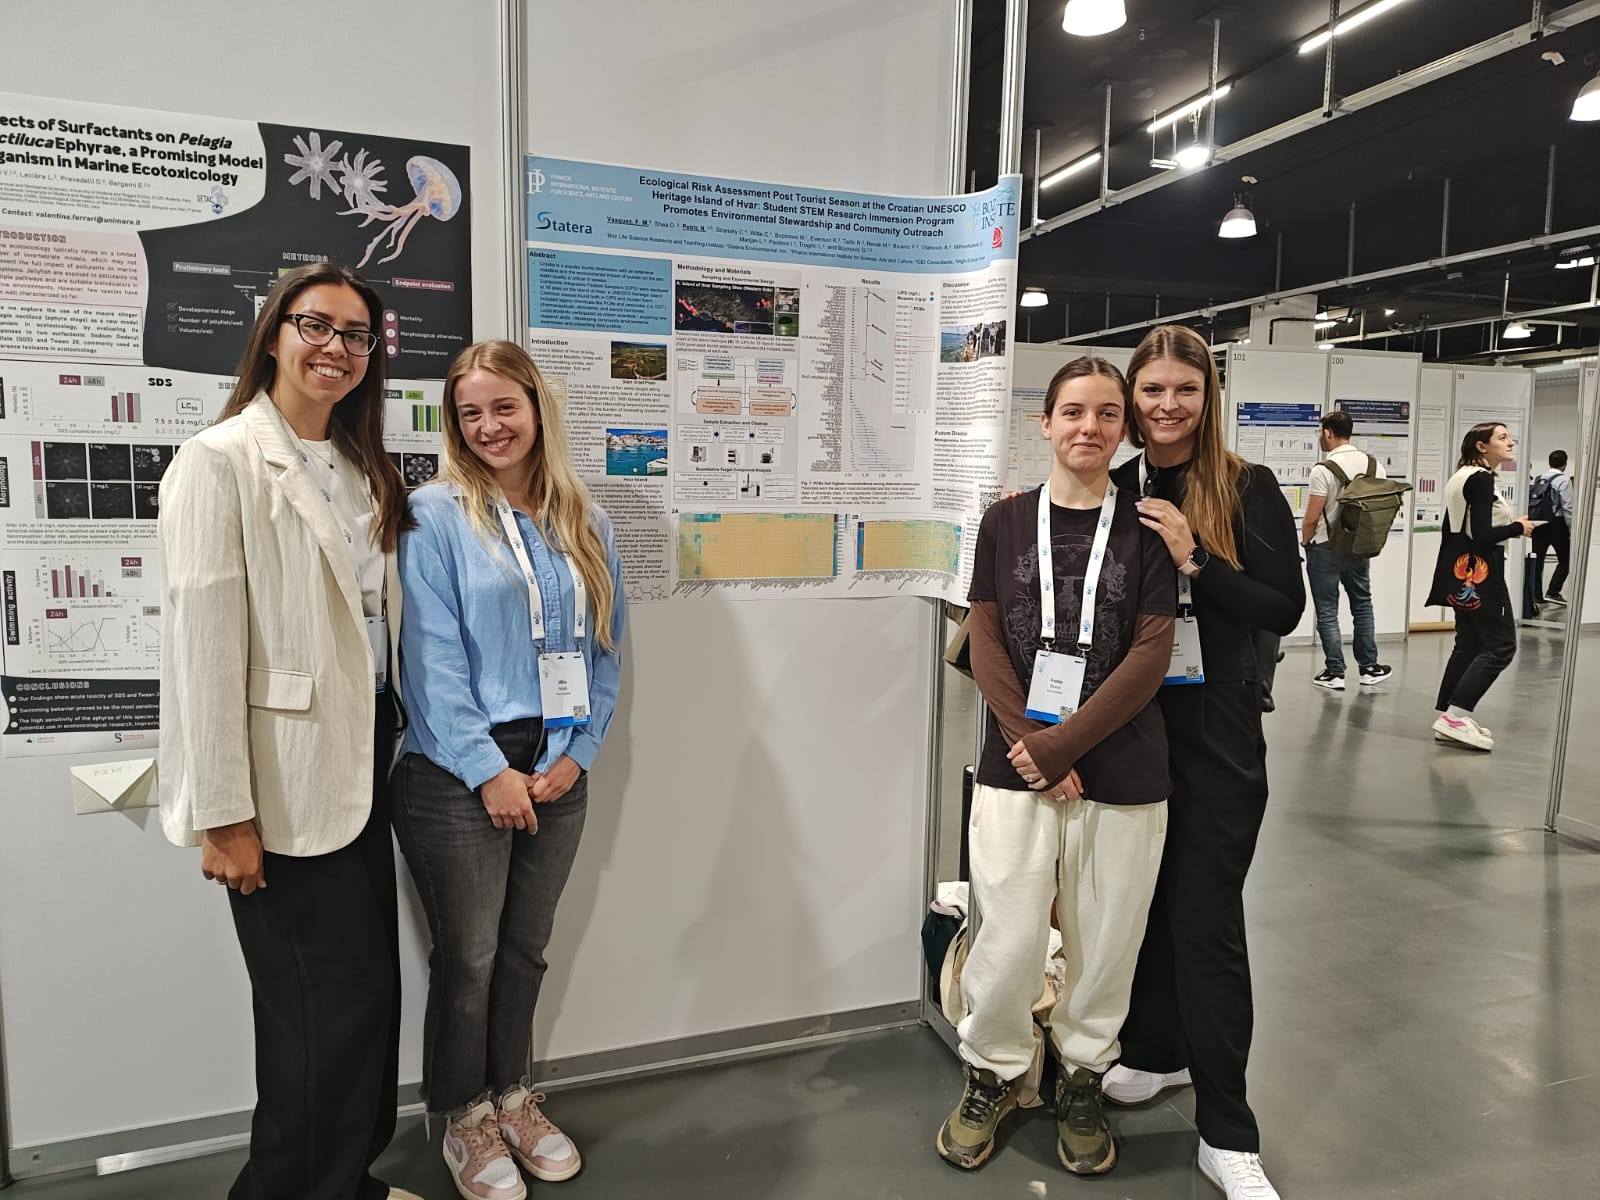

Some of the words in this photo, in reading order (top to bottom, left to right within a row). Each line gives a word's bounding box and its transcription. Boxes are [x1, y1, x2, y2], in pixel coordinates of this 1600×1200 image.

[38, 118, 56, 130] of
[58, 120, 153, 141] Surfactants
[156, 132, 176, 144] on
[178, 132, 232, 150] Pelagia
[55, 137, 126, 156] Ephyrae,
[129, 147, 138, 156] a
[140, 146, 216, 167] Promising
[218, 154, 263, 169] Model
[57, 154, 72, 168] in
[75, 156, 130, 173] Marine
[132, 162, 238, 186] Ecotoxicology
[550, 182, 590, 192] INTERNATIONAL
[640, 176, 689, 190] Ecological
[692, 182, 712, 192] Risk
[714, 184, 770, 198] Assessment
[773, 190, 794, 200] Post
[796, 193, 826, 204] Tourist
[828, 196, 860, 208] Season
[872, 202, 886, 210] the
[888, 203, 924, 213] Croatian
[926, 204, 966, 214] UNESCO
[2, 208, 34, 216] Contact:
[652, 190, 692, 204] Heritage
[694, 194, 722, 206] Island
[724, 198, 734, 207] of
[736, 200, 760, 210] Hvar:
[763, 202, 798, 214] Student
[800, 206, 825, 216] STEM
[827, 208, 866, 220] Research
[869, 213, 914, 225] Immersion
[916, 216, 954, 228] Program
[997, 202, 1016, 216] TE
[536, 211, 592, 234] Statera
[663, 204, 708, 217] Promotes
[712, 209, 776, 224] Environmental
[778, 216, 832, 230] Stewardship
[835, 222, 850, 230] and
[853, 224, 901, 238] Community
[903, 228, 944, 237] Outreach
[176, 264, 212, 273] Preliminary
[678, 264, 713, 272] Methodology
[178, 306, 220, 314] Developmental
[532, 338, 568, 346] Introduction
[1234, 353, 1246, 362] 101
[63, 376, 78, 385] 24h
[148, 378, 172, 387] SDS
[186, 419, 206, 428] mg/L
[6, 602, 16, 642] Swimming
[16, 682, 90, 692] CONCLUSIONS
